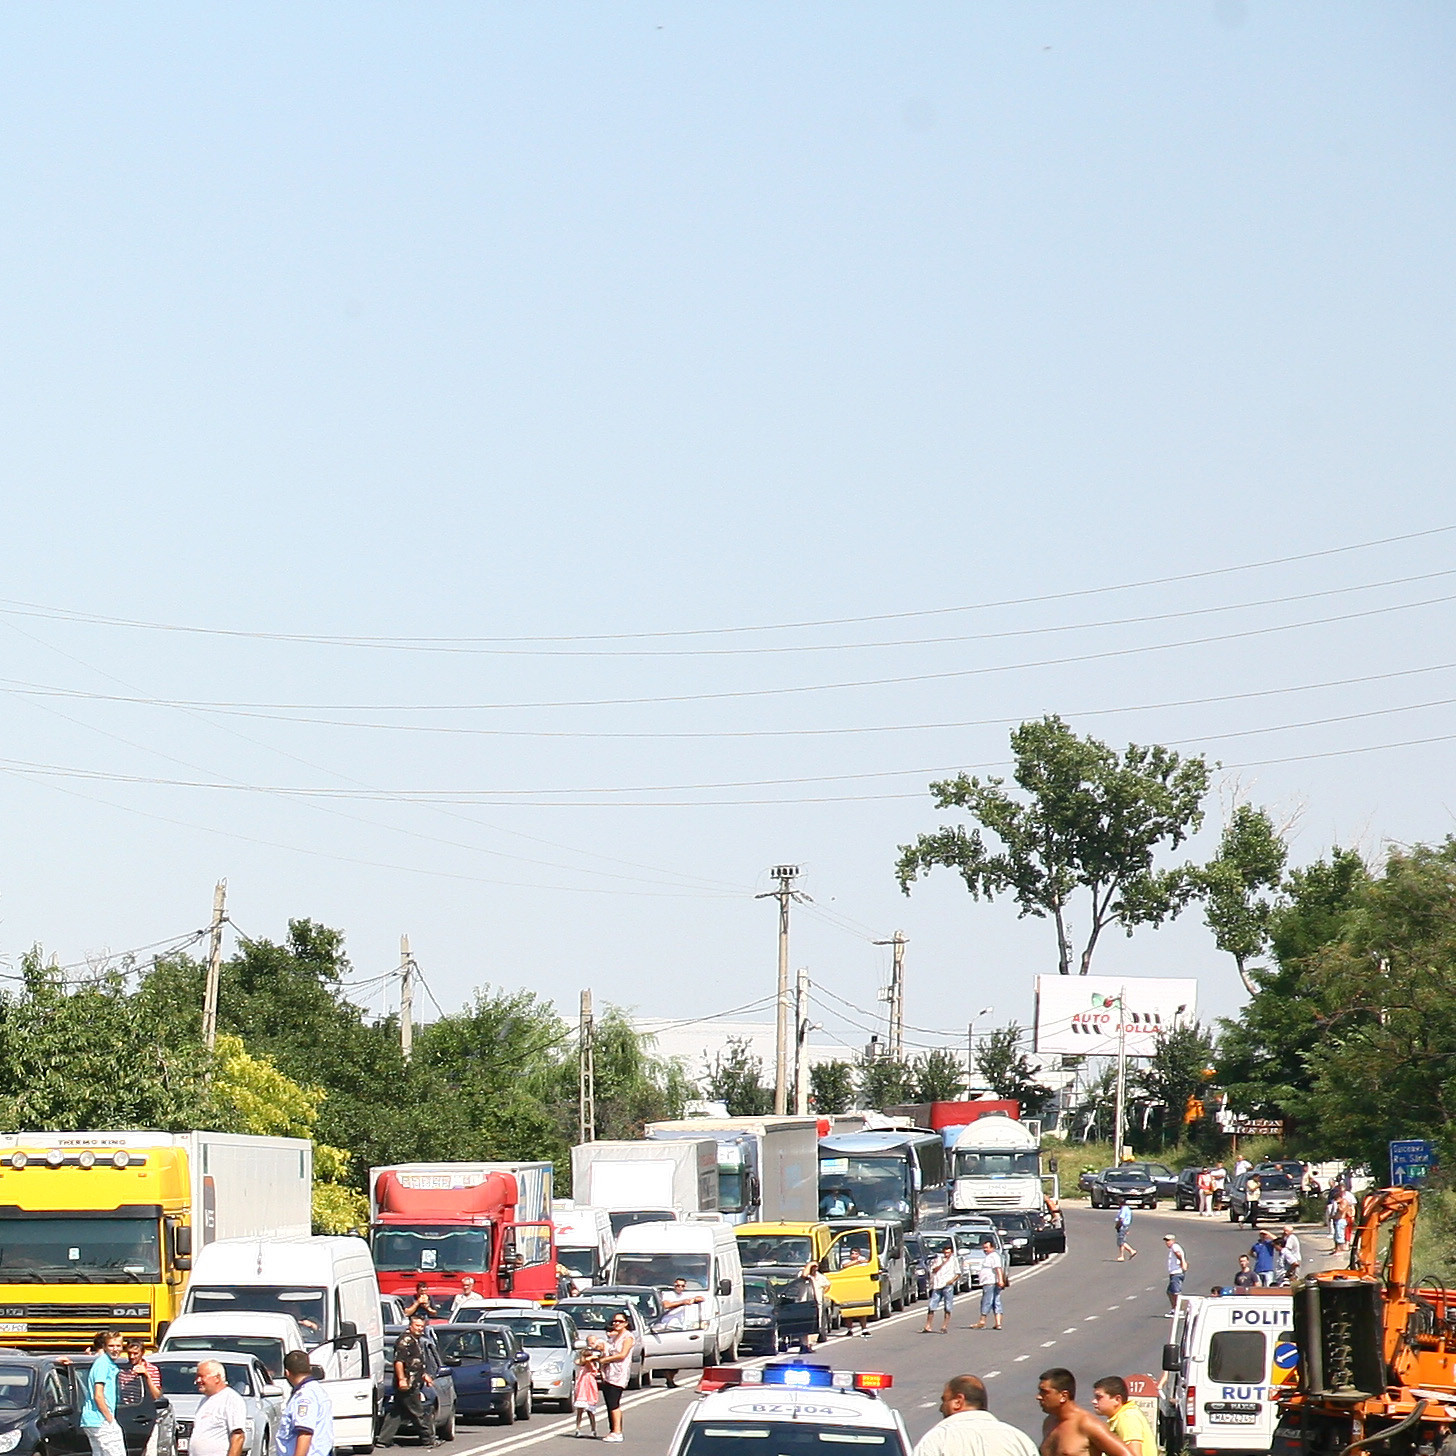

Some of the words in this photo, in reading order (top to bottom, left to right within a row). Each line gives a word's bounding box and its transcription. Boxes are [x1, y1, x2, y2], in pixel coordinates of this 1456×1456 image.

[1072, 1013, 1110, 1024] AUTO
[57, 1138, 99, 1146] THERMO
[112, 1308, 150, 1316] DAF
[1231, 1310, 1291, 1326] POLIT
[1222, 1386, 1267, 1400] RUT
[751, 1403, 835, 1415] BZ-104
